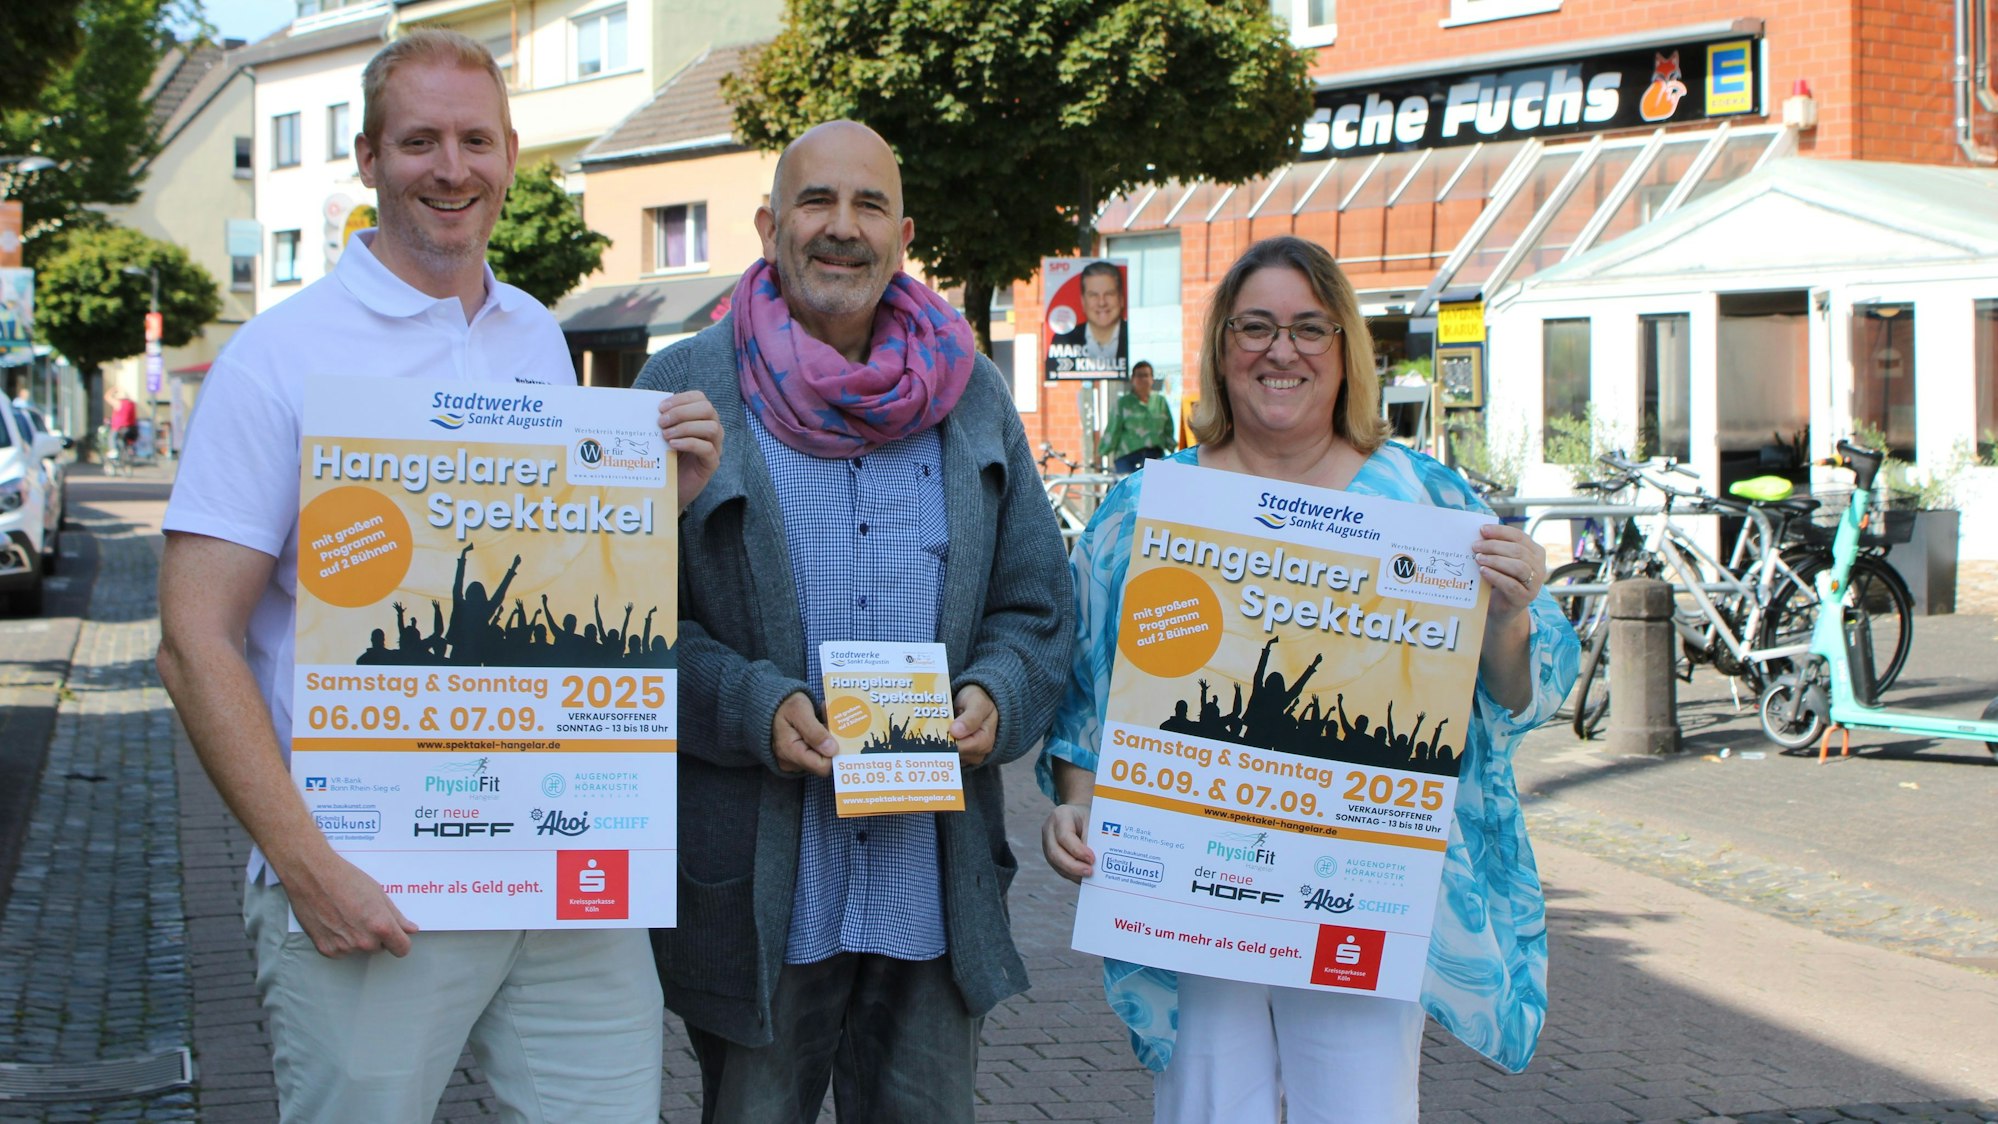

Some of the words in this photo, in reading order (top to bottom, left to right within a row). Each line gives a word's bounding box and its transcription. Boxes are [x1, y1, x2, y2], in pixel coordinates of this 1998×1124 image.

[1300, 94, 1430, 153] sche
[1441, 69, 1623, 139] Fuchs
[1048, 263, 1070, 272] SPD
[432, 392, 543, 413] Stadtwerke
[468, 413, 504, 425] Sankt
[507, 415, 563, 429] Augustin
[616, 429, 646, 437] Hangelar
[612, 448, 624, 456] für
[312, 444, 557, 492] Hangelarer
[603, 456, 660, 470] Hangelar!
[427, 492, 654, 540] Spektakel
[1258, 492, 1364, 524] Stadtwerke
[312, 534, 333, 550] mit
[335, 515, 383, 543] großem
[1289, 516, 1324, 531] Sankt
[1325, 522, 1381, 541] Augustin
[320, 530, 386, 562] Programm
[1391, 543, 1429, 554] Werbekreis
[1431, 549, 1463, 559] Hangelar
[320, 561, 340, 578] auf
[341, 559, 350, 569] 2
[350, 541, 397, 565] Bühnen
[1141, 526, 1368, 594] Hangelarer
[1426, 566, 1437, 574] für
[1415, 573, 1473, 591] Hangelar!
[1133, 608, 1153, 621] mit
[1155, 598, 1199, 617] großem
[1240, 584, 1460, 651] Spektakel
[1139, 611, 1200, 632] Programm
[1137, 634, 1156, 647] auf
[1157, 632, 1165, 642] 2
[1166, 622, 1209, 640] Bühnen
[831, 651, 880, 659] Stadtwerke
[306, 673, 418, 698] Samstag
[425, 674, 440, 691] &
[448, 674, 548, 699] Sonntag
[561, 675, 665, 709] 2025
[830, 676, 913, 691] Hangelarer
[870, 690, 948, 706] Spektakel
[308, 705, 410, 731] 06.09.
[419, 706, 440, 731] &
[450, 706, 544, 732] 07.09.
[568, 713, 657, 721] VERKAUFSOFFENER
[913, 706, 949, 719] 2025
[557, 724, 603, 733] SONNTAG
[612, 724, 622, 732] 13
[623, 724, 638, 733] bis
[640, 724, 649, 733] 18
[651, 725, 668, 733] Uhr
[417, 741, 561, 751] www.spektakel-hangelar.de
[838, 760, 892, 771] Samstag
[895, 759, 902, 768] &
[906, 759, 954, 770] Sonntag
[1113, 729, 1212, 767] Samstag
[1217, 749, 1231, 766] &
[1238, 752, 1333, 789] Sonntag
[425, 775, 500, 796] PhysioFit
[574, 782, 638, 791] HÖRAKUSTIK
[841, 771, 890, 785] 06.09.
[894, 771, 905, 783] &
[908, 770, 954, 783] 07.09.
[1111, 759, 1200, 797] 06.09.
[1208, 778, 1227, 802] &
[1236, 783, 1324, 818] 07.09.
[1343, 771, 1445, 811] 2025
[414, 806, 438, 818] der
[443, 808, 479, 818] neue
[1204, 808, 1338, 836] www.spektakel-hangelar.de
[1348, 804, 1433, 822] VERKAUFSOFFENER
[316, 816, 376, 829] baukunst
[413, 822, 514, 837] HOFF
[537, 810, 590, 837] Ahoi
[593, 817, 649, 831] SCHIFF
[1124, 825, 1151, 836] VR-Bank
[1335, 813, 1380, 826] SONNTAG
[1388, 819, 1397, 828] 13
[1398, 820, 1412, 830] bis
[1414, 822, 1423, 831] 18
[1425, 825, 1442, 834] Uhr
[1207, 840, 1276, 865] PhysioFit
[1106, 857, 1159, 878] baukunst
[1345, 867, 1405, 880] HÖRAKUSTIK
[1346, 859, 1406, 871] AUGENOPTIK
[1194, 866, 1216, 879] der
[1220, 871, 1253, 886] neue
[382, 884, 403, 894] um
[407, 881, 444, 894] mehr
[448, 881, 468, 893] als
[472, 881, 503, 893] Geld
[507, 881, 543, 897] geht.
[1191, 880, 1284, 904] HOFF
[569, 898, 615, 907] Kreissparkasse
[585, 905, 599, 913] Köln
[1304, 888, 1355, 914] Ahoi
[1357, 899, 1410, 916] SCHIFF
[1114, 918, 1151, 935] Weil's
[1155, 928, 1175, 940] um
[1178, 933, 1212, 946] mehr
[1215, 938, 1233, 950] als
[1237, 940, 1266, 954] Geld
[1270, 945, 1302, 959] geht.
[1324, 967, 1366, 977] Kreissparkasse
